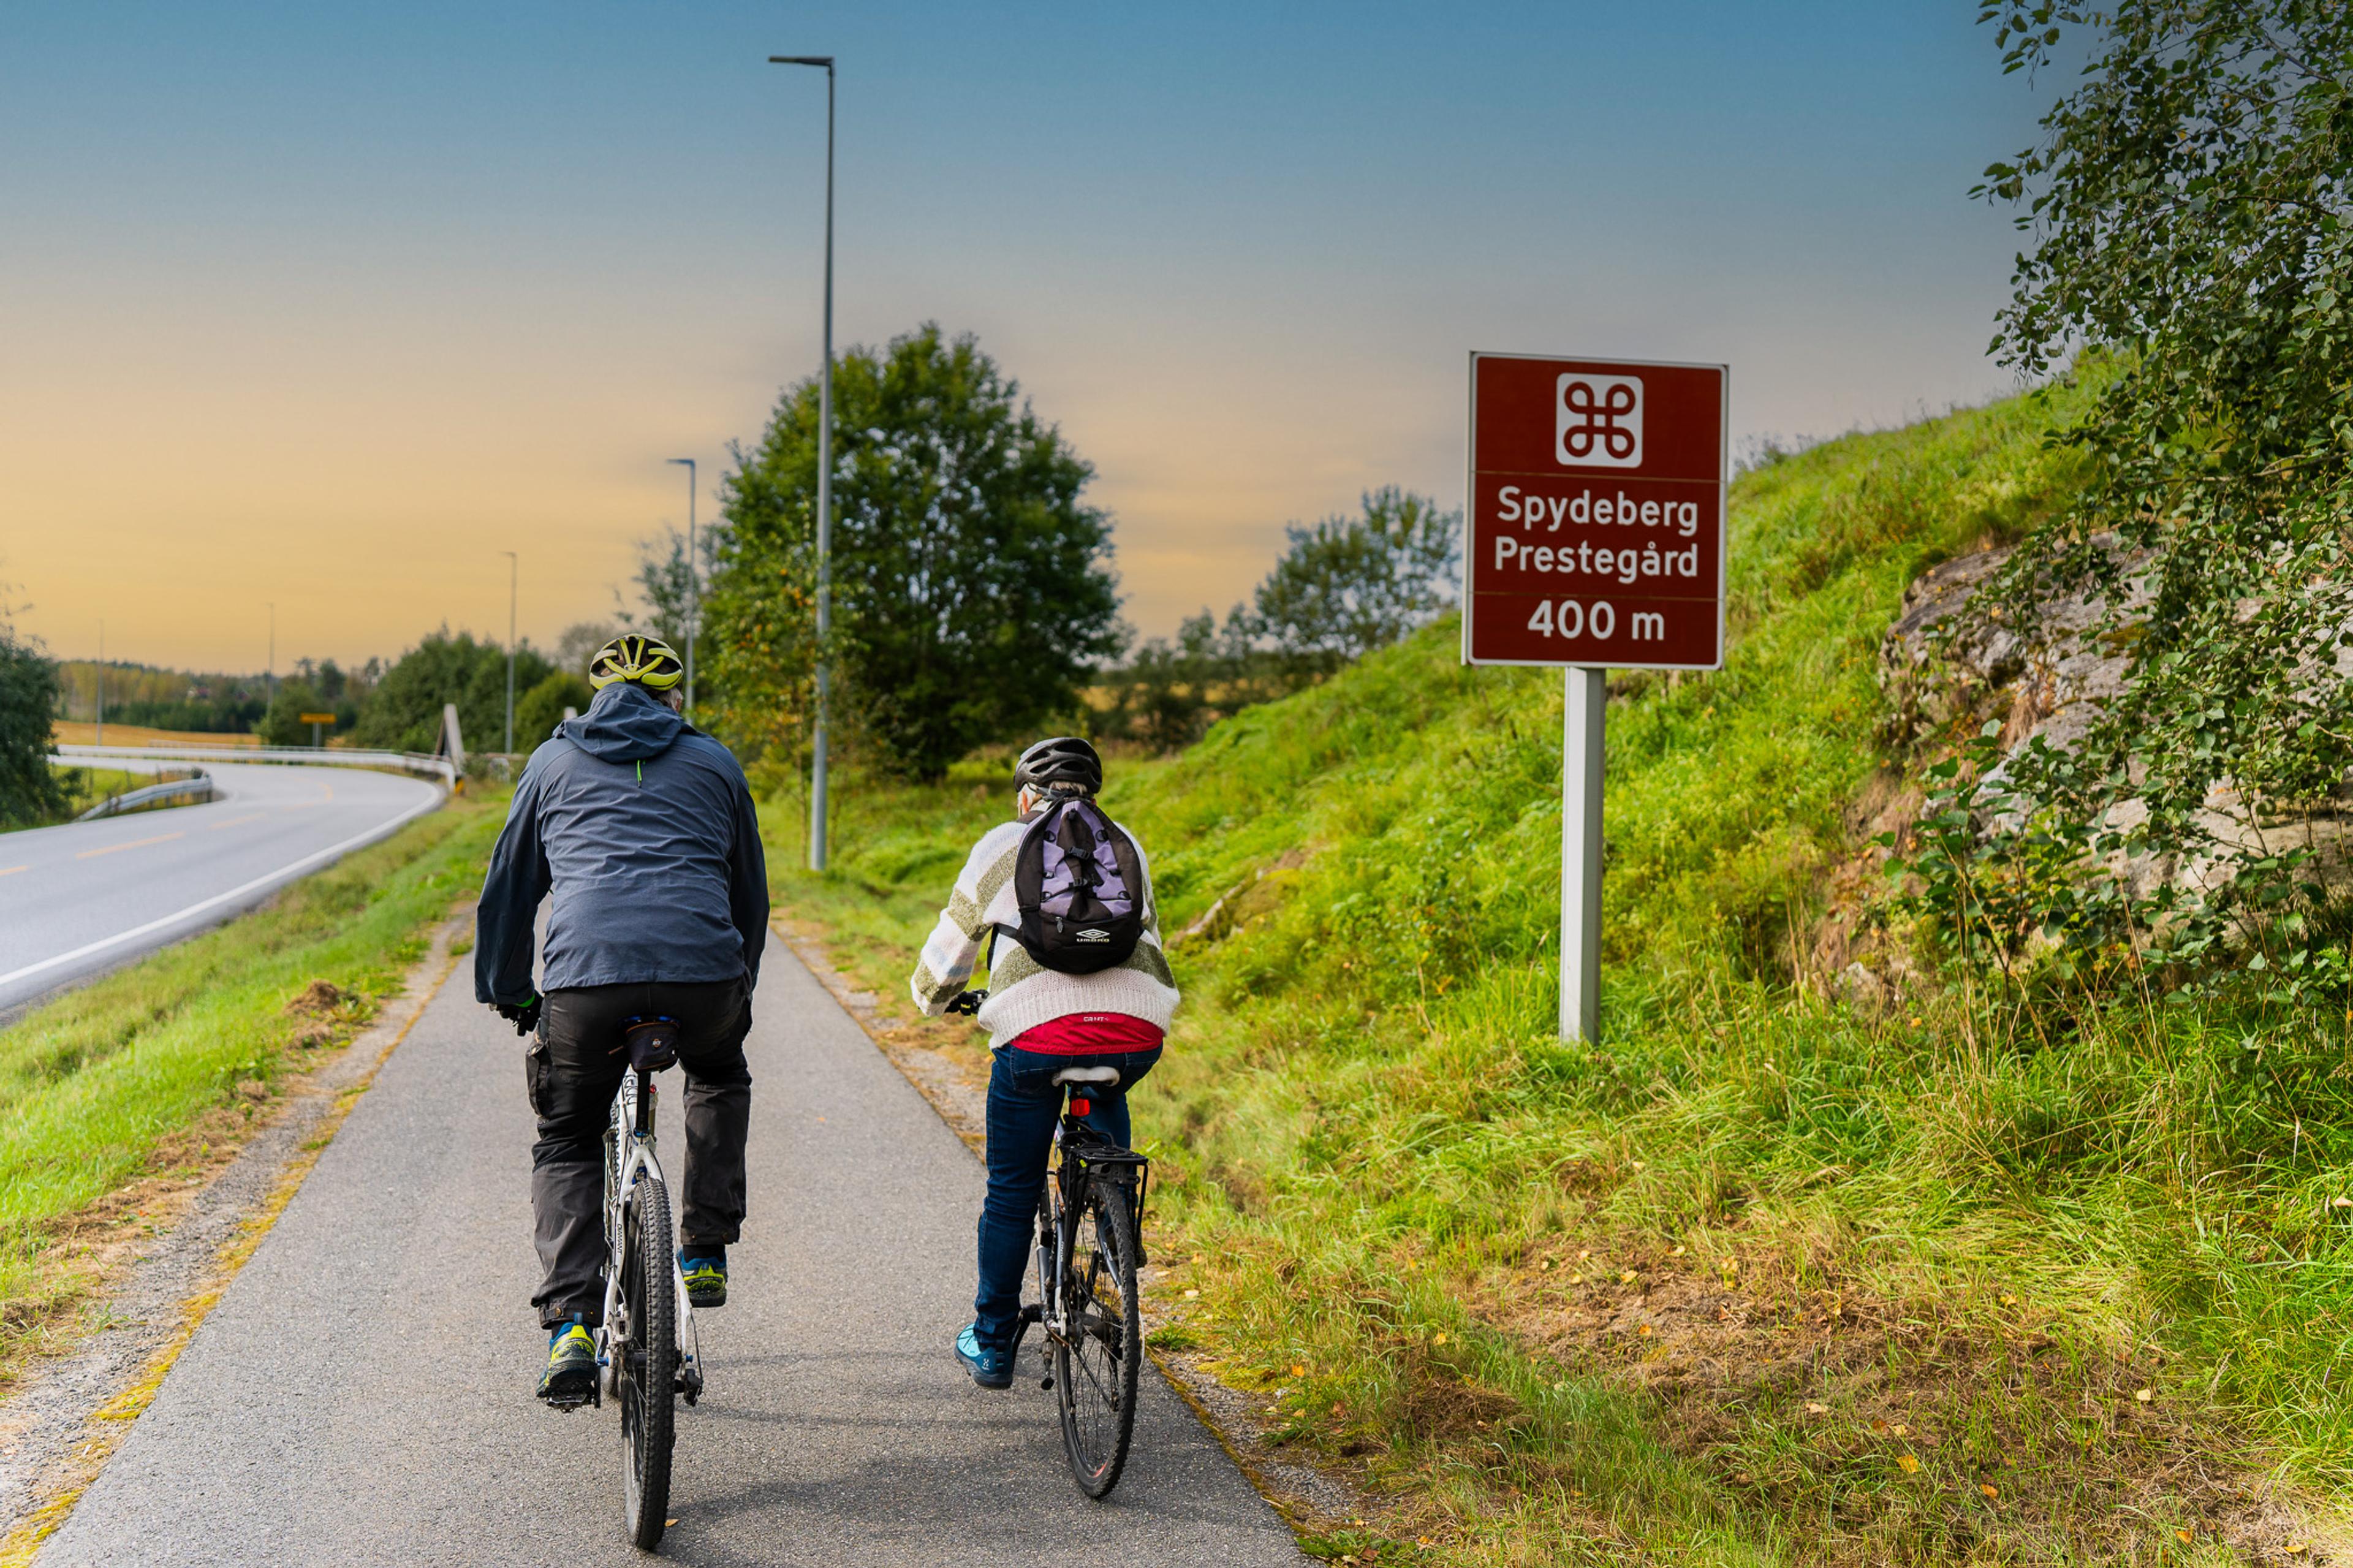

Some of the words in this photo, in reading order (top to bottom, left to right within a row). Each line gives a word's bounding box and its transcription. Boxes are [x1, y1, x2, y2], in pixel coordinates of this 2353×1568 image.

[1497, 486, 1698, 537] Spydeberg
[1495, 536, 1698, 585] Prestegård
[1528, 599, 1615, 640] 400
[1631, 612, 1665, 641] m
